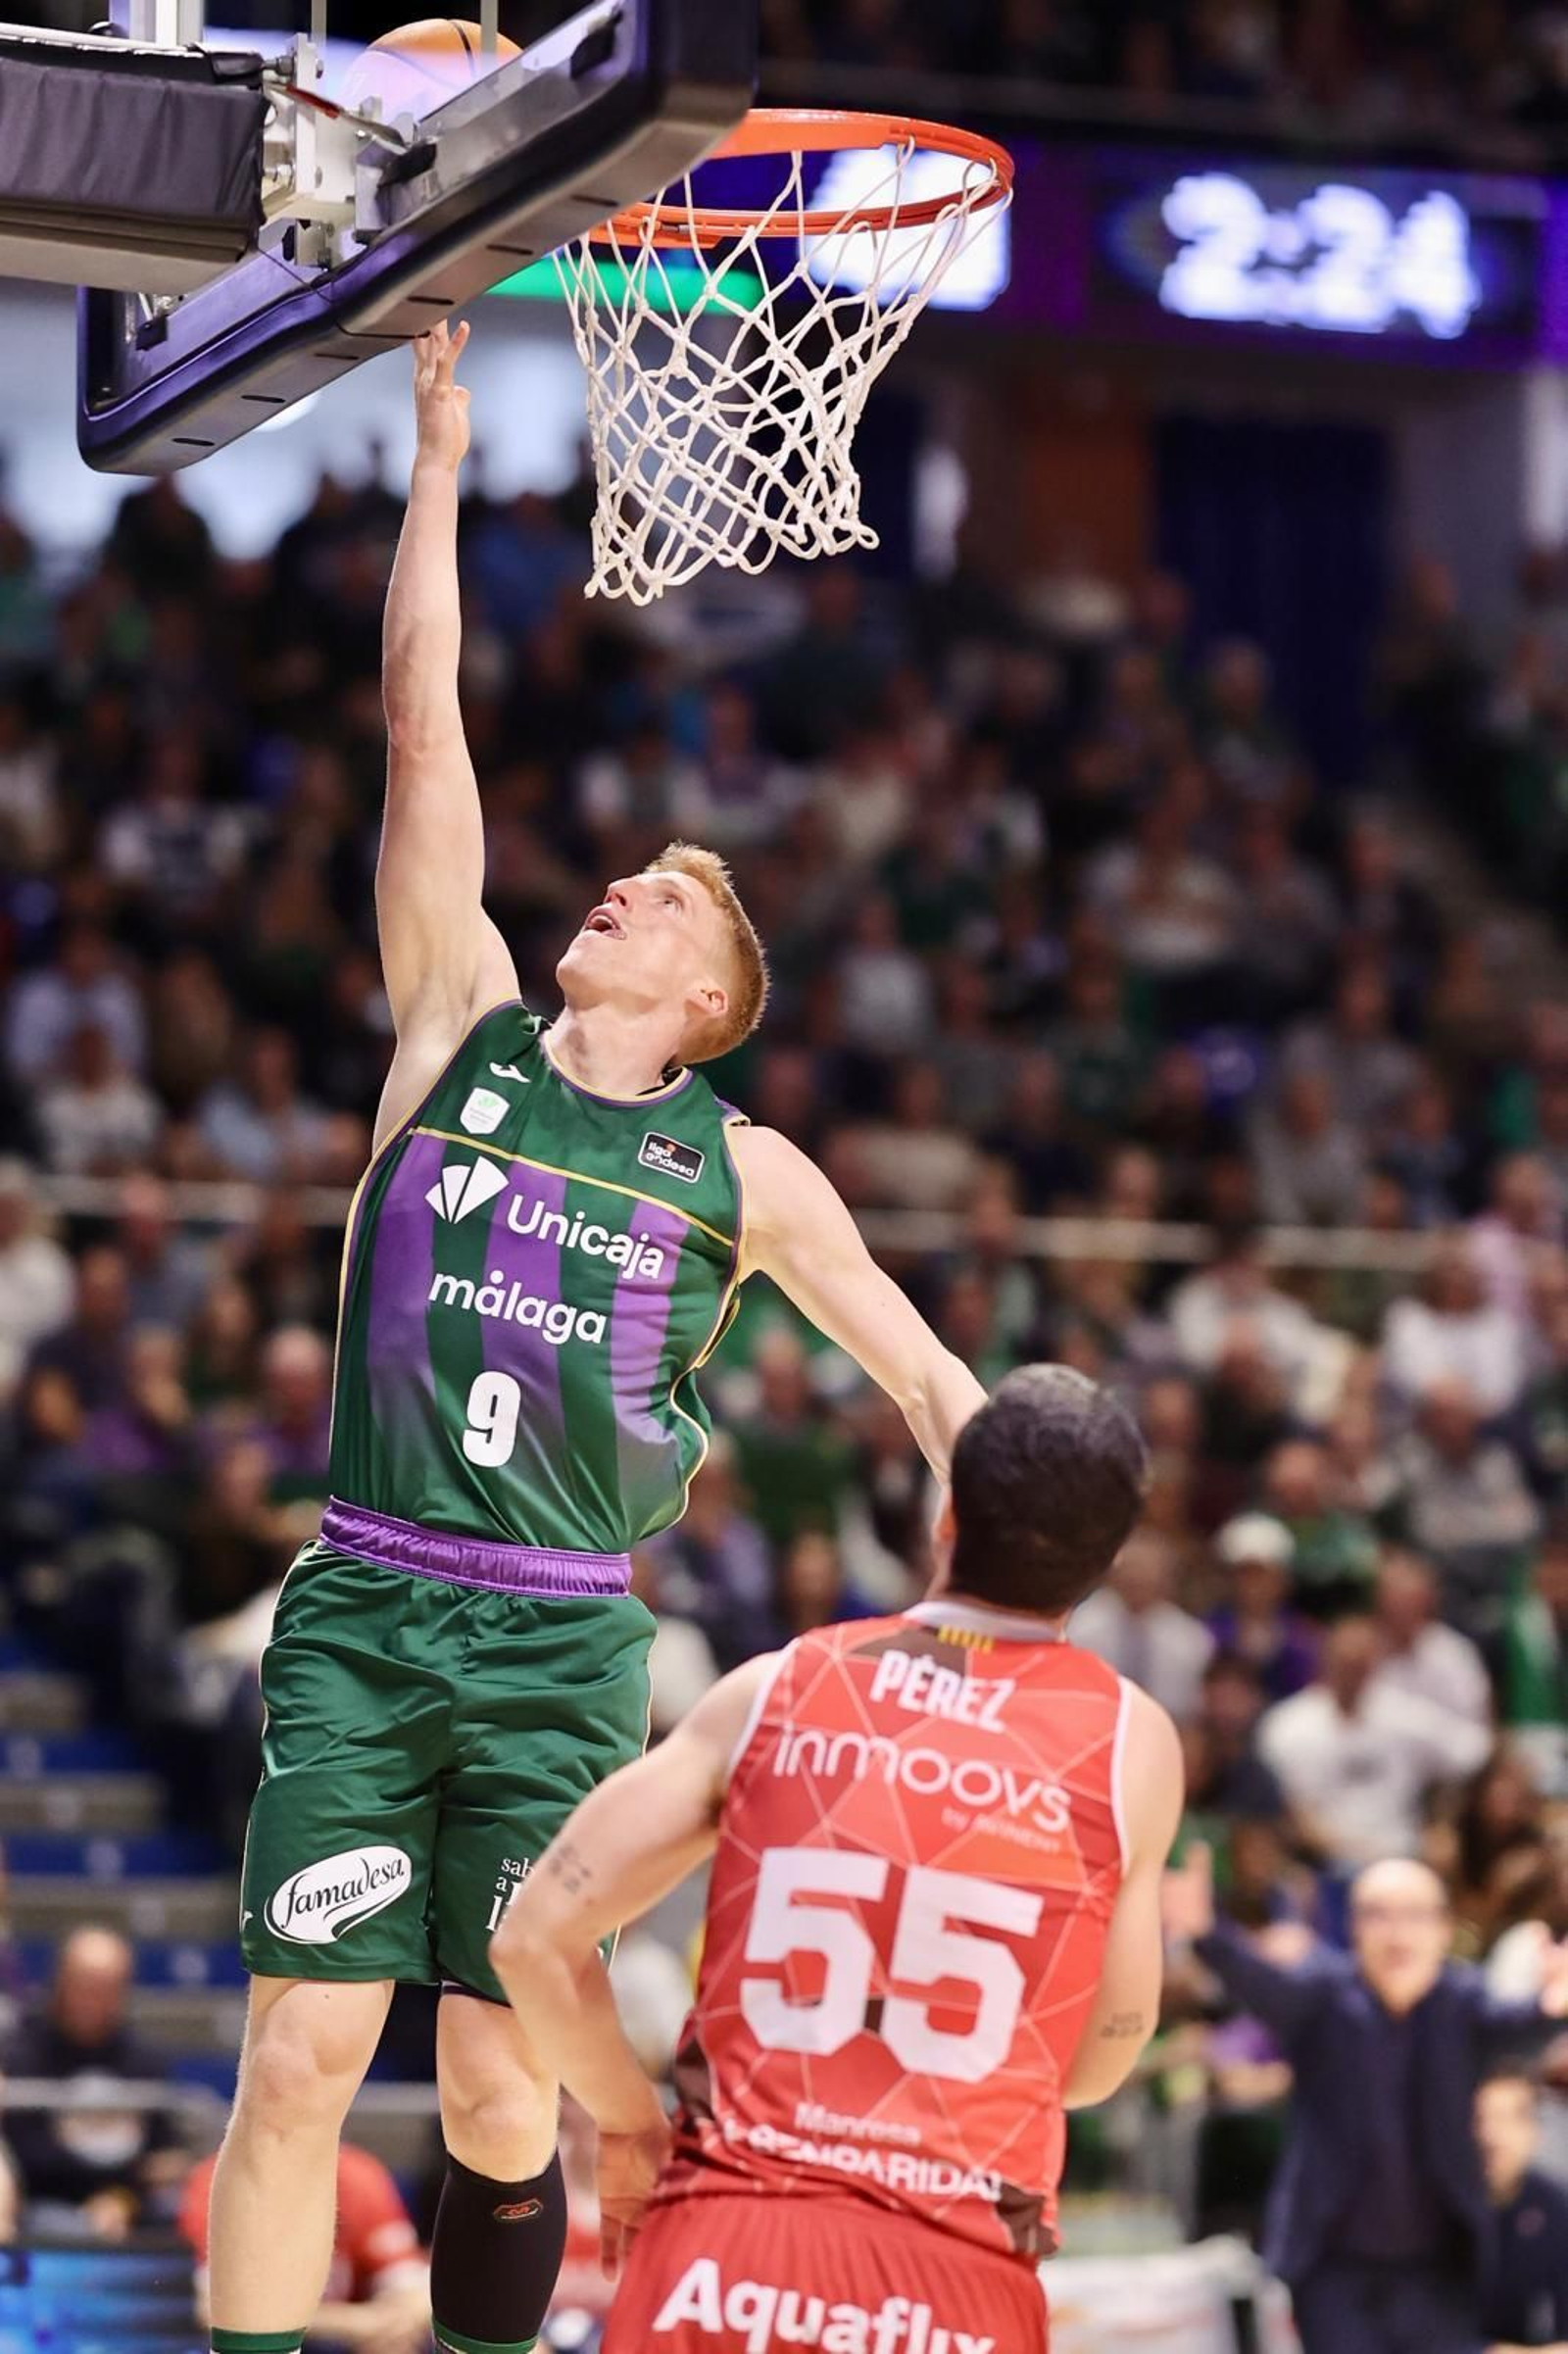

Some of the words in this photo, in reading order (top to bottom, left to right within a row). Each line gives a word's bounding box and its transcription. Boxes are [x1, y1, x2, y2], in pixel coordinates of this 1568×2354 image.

[1159, 172, 1481, 339] 2:24
[646, 1152, 695, 1178] endesa
[508, 1193, 664, 1281] Unicaja
[428, 1270, 608, 1345] málaga
[462, 1371, 521, 1467] 9
[869, 1648, 1017, 1733] PÉREZ
[772, 1720, 1072, 1834] inmoovs
[281, 1856, 406, 1929] famadesa
[740, 1847, 1045, 2084] 55
